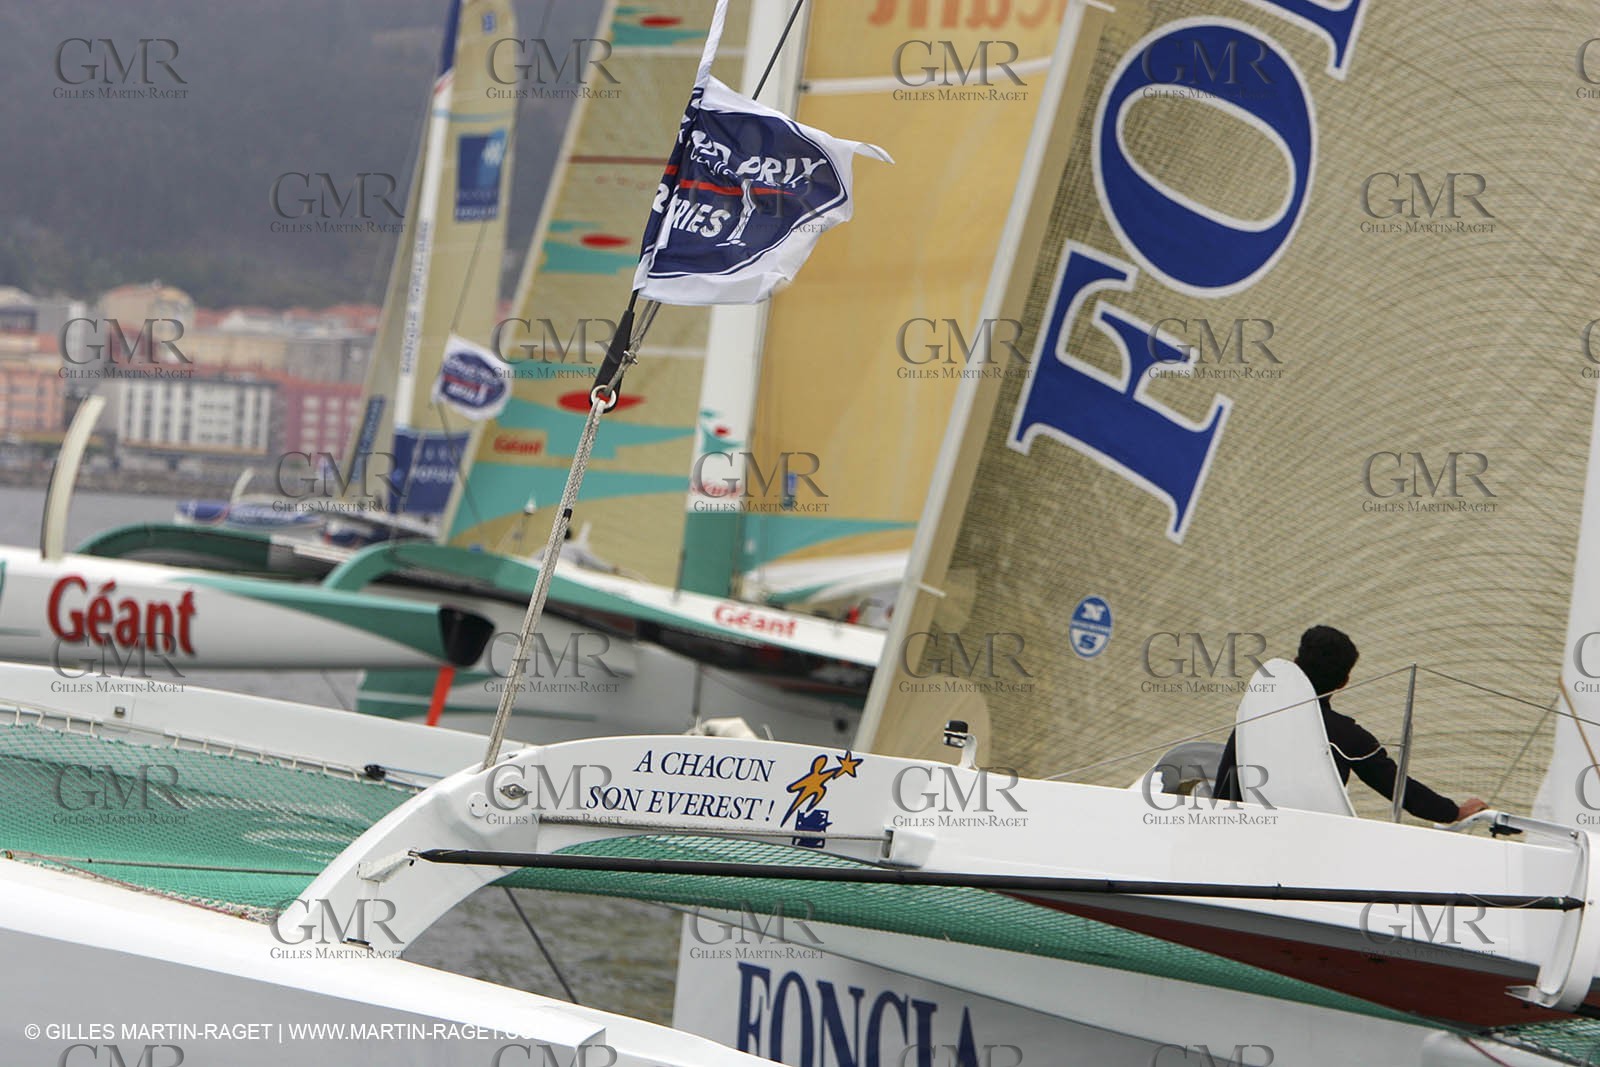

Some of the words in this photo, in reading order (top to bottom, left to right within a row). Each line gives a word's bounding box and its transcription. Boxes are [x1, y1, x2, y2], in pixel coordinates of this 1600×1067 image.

[48, 576, 197, 655] Géant
[714, 604, 798, 638] Géant
[632, 750, 654, 773] A
[660, 752, 776, 782] CHACUN
[586, 785, 644, 811] SON
[645, 789, 763, 821] EVEREST
